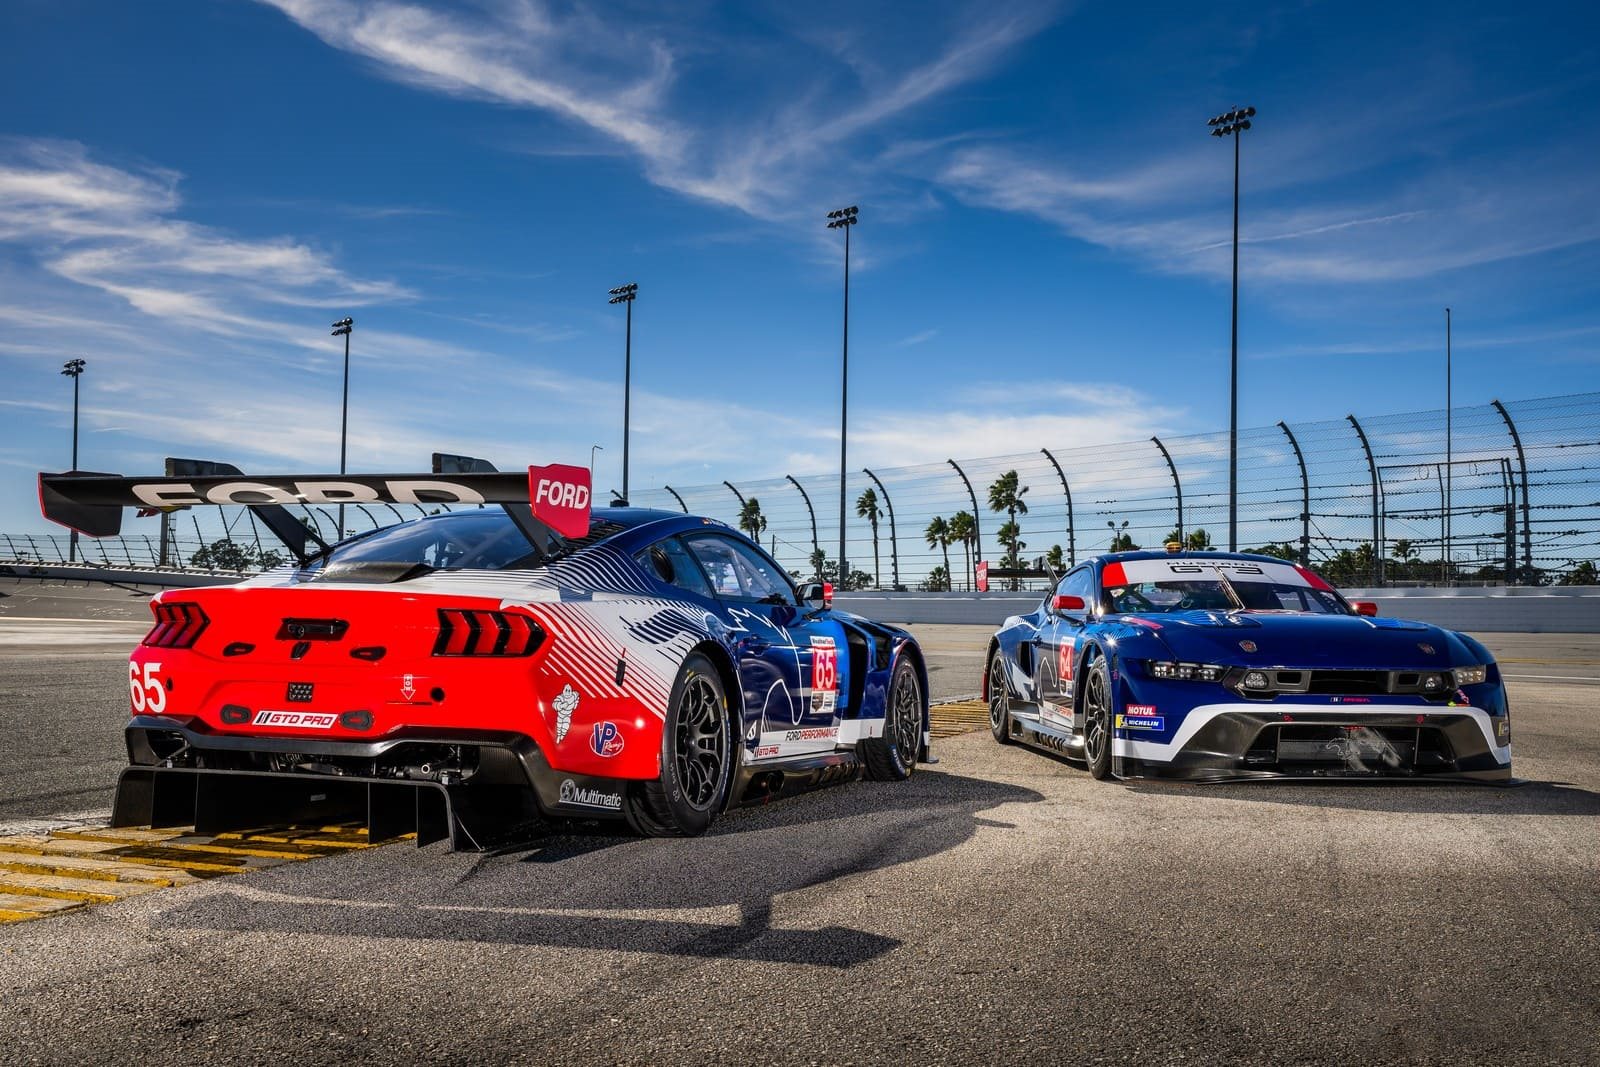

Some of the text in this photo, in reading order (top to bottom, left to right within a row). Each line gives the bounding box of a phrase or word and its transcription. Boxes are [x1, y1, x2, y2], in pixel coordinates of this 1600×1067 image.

[536, 479, 589, 509] FORD
[1170, 566, 1264, 575] GT3
[816, 652, 835, 689] 65
[1060, 646, 1071, 679] 64
[129, 660, 166, 713] 65
[270, 714, 333, 726] GTD PRO
[1127, 706, 1154, 715] MOTUL
[1128, 719, 1160, 727] MICHELIN
[593, 721, 617, 755] VP
[574, 787, 622, 807] Multimatic
